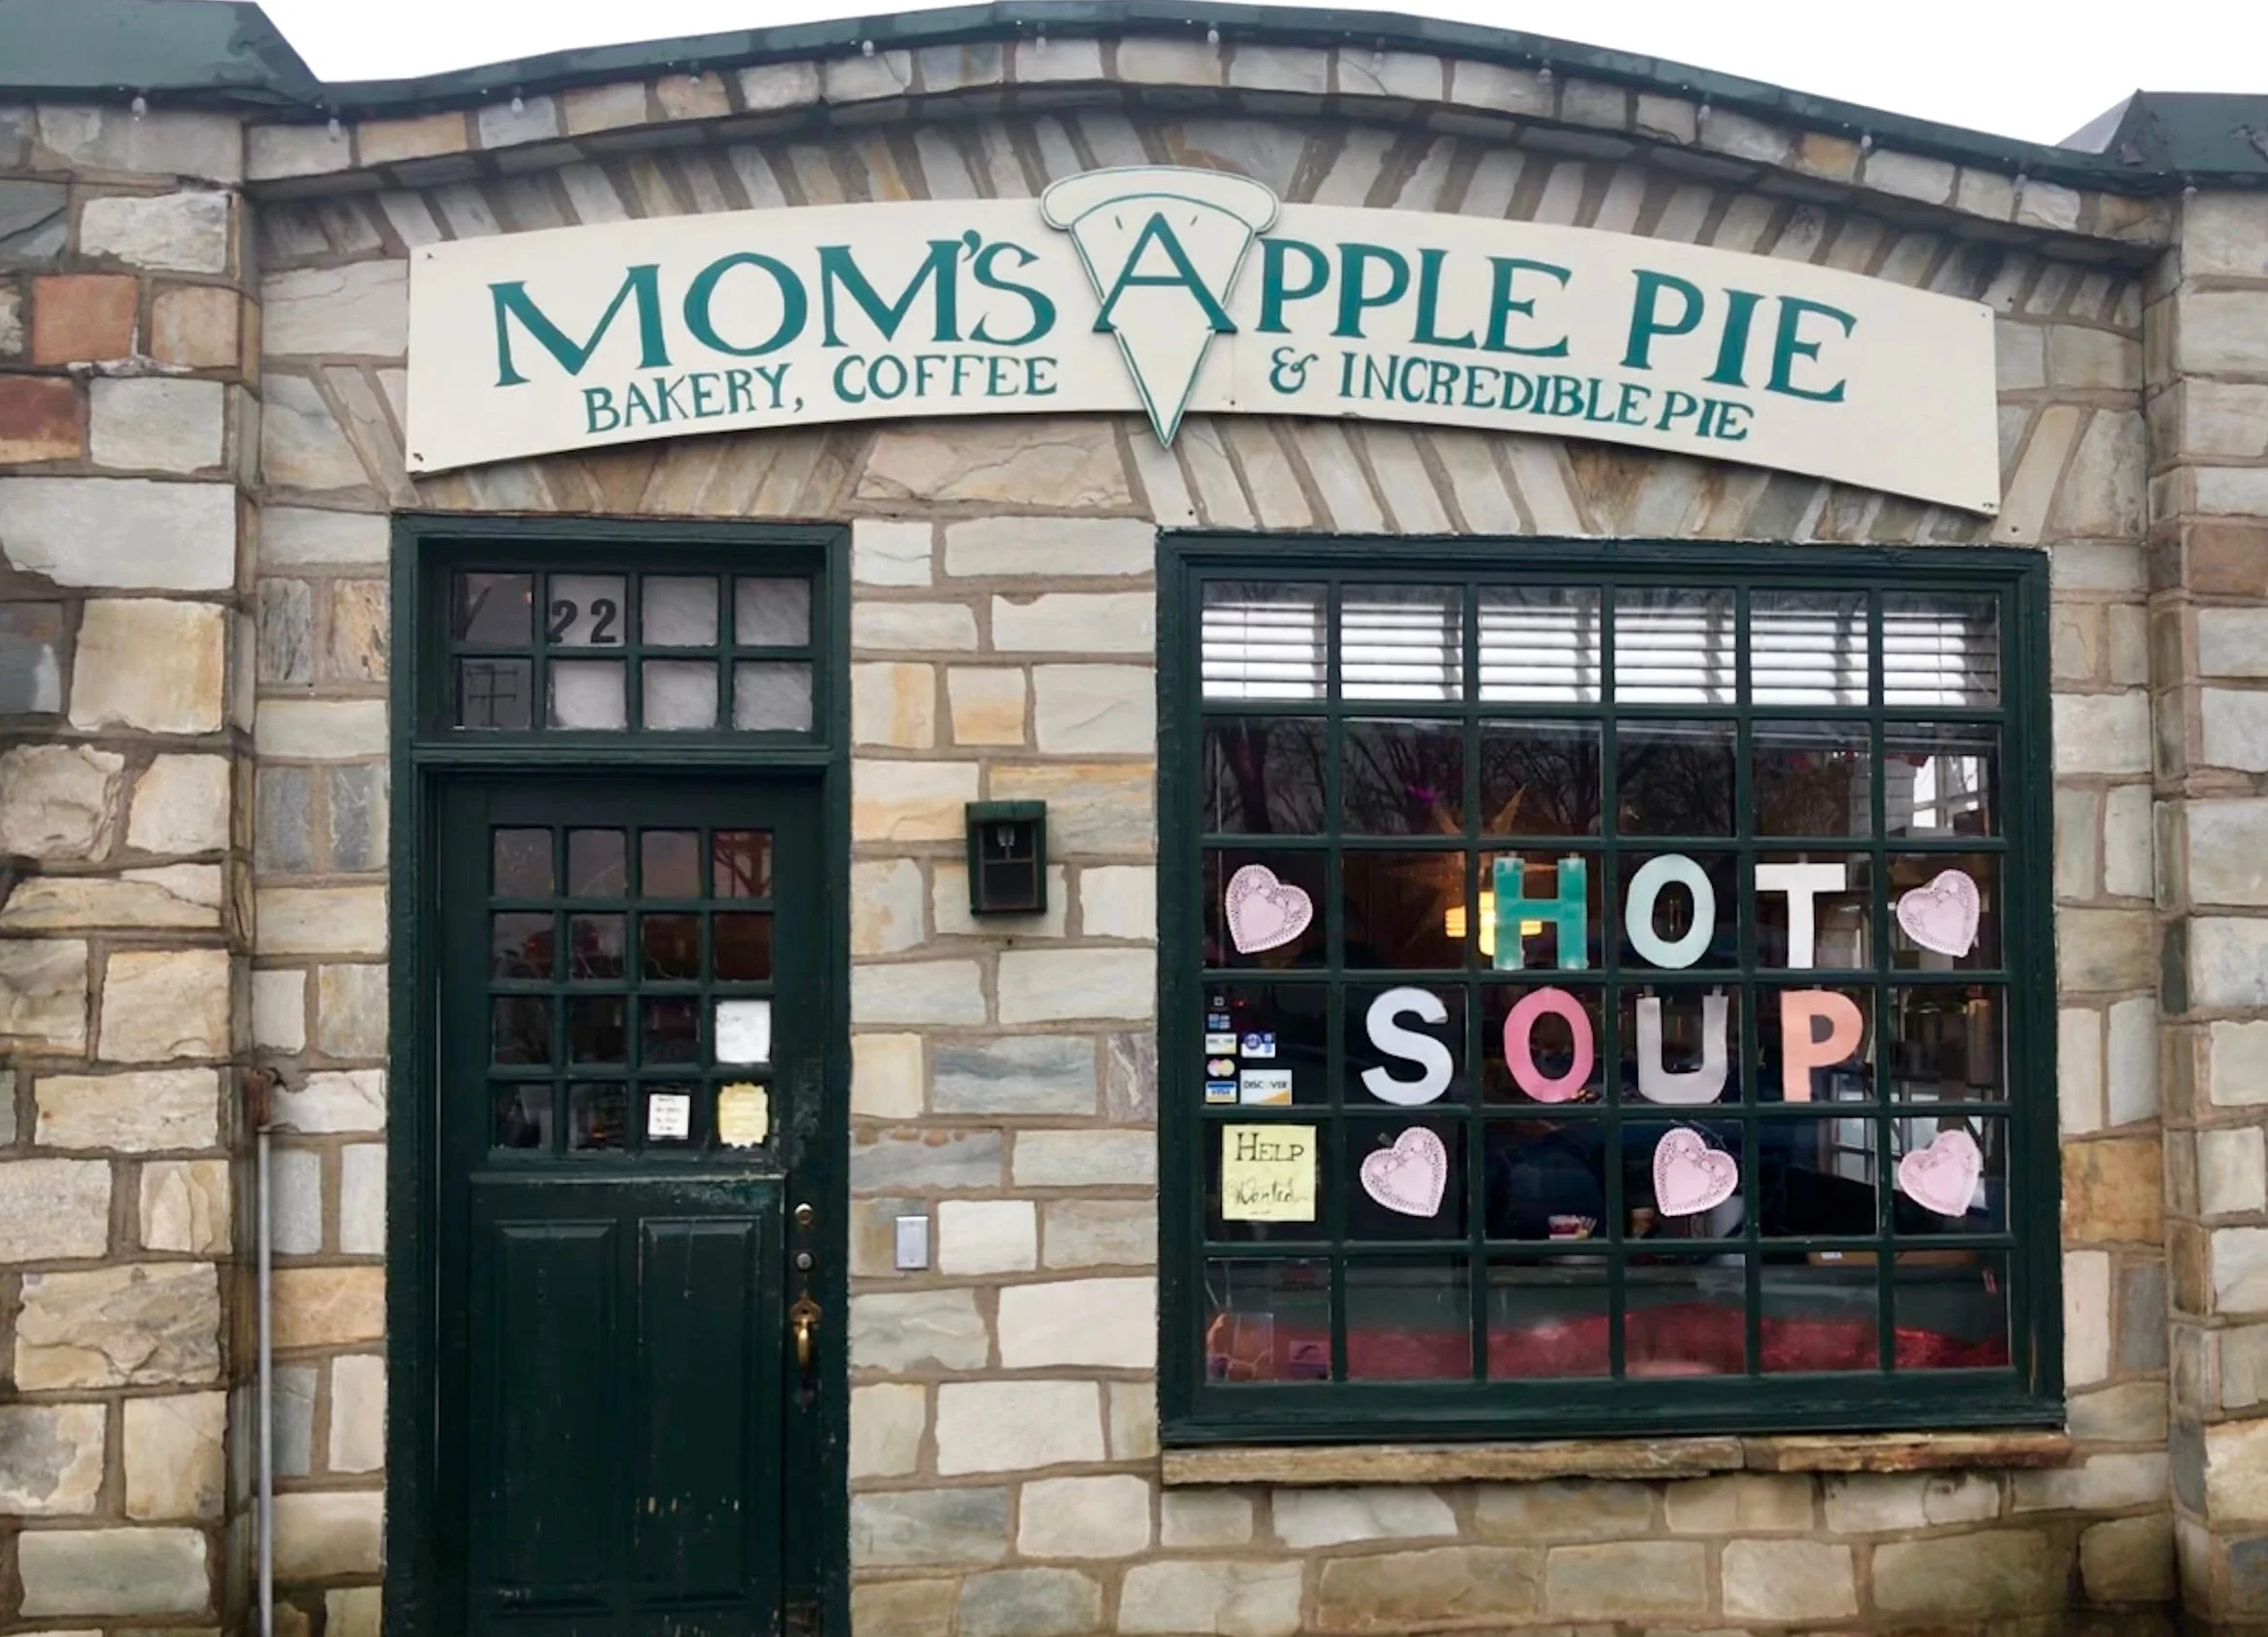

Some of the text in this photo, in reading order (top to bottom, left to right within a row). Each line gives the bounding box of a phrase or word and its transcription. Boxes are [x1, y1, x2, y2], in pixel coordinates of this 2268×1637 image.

[488, 213, 1857, 404] MOM'S APPLE PIE
[582, 345, 1757, 442] BAKERY, COFFEE & INCREDIBLE PIE
[1492, 853, 1847, 970] HOT
[1241, 1080, 1288, 1090] DISCVER
[1359, 986, 1865, 1106] SOUP
[1234, 1132, 1306, 1162] HELP
